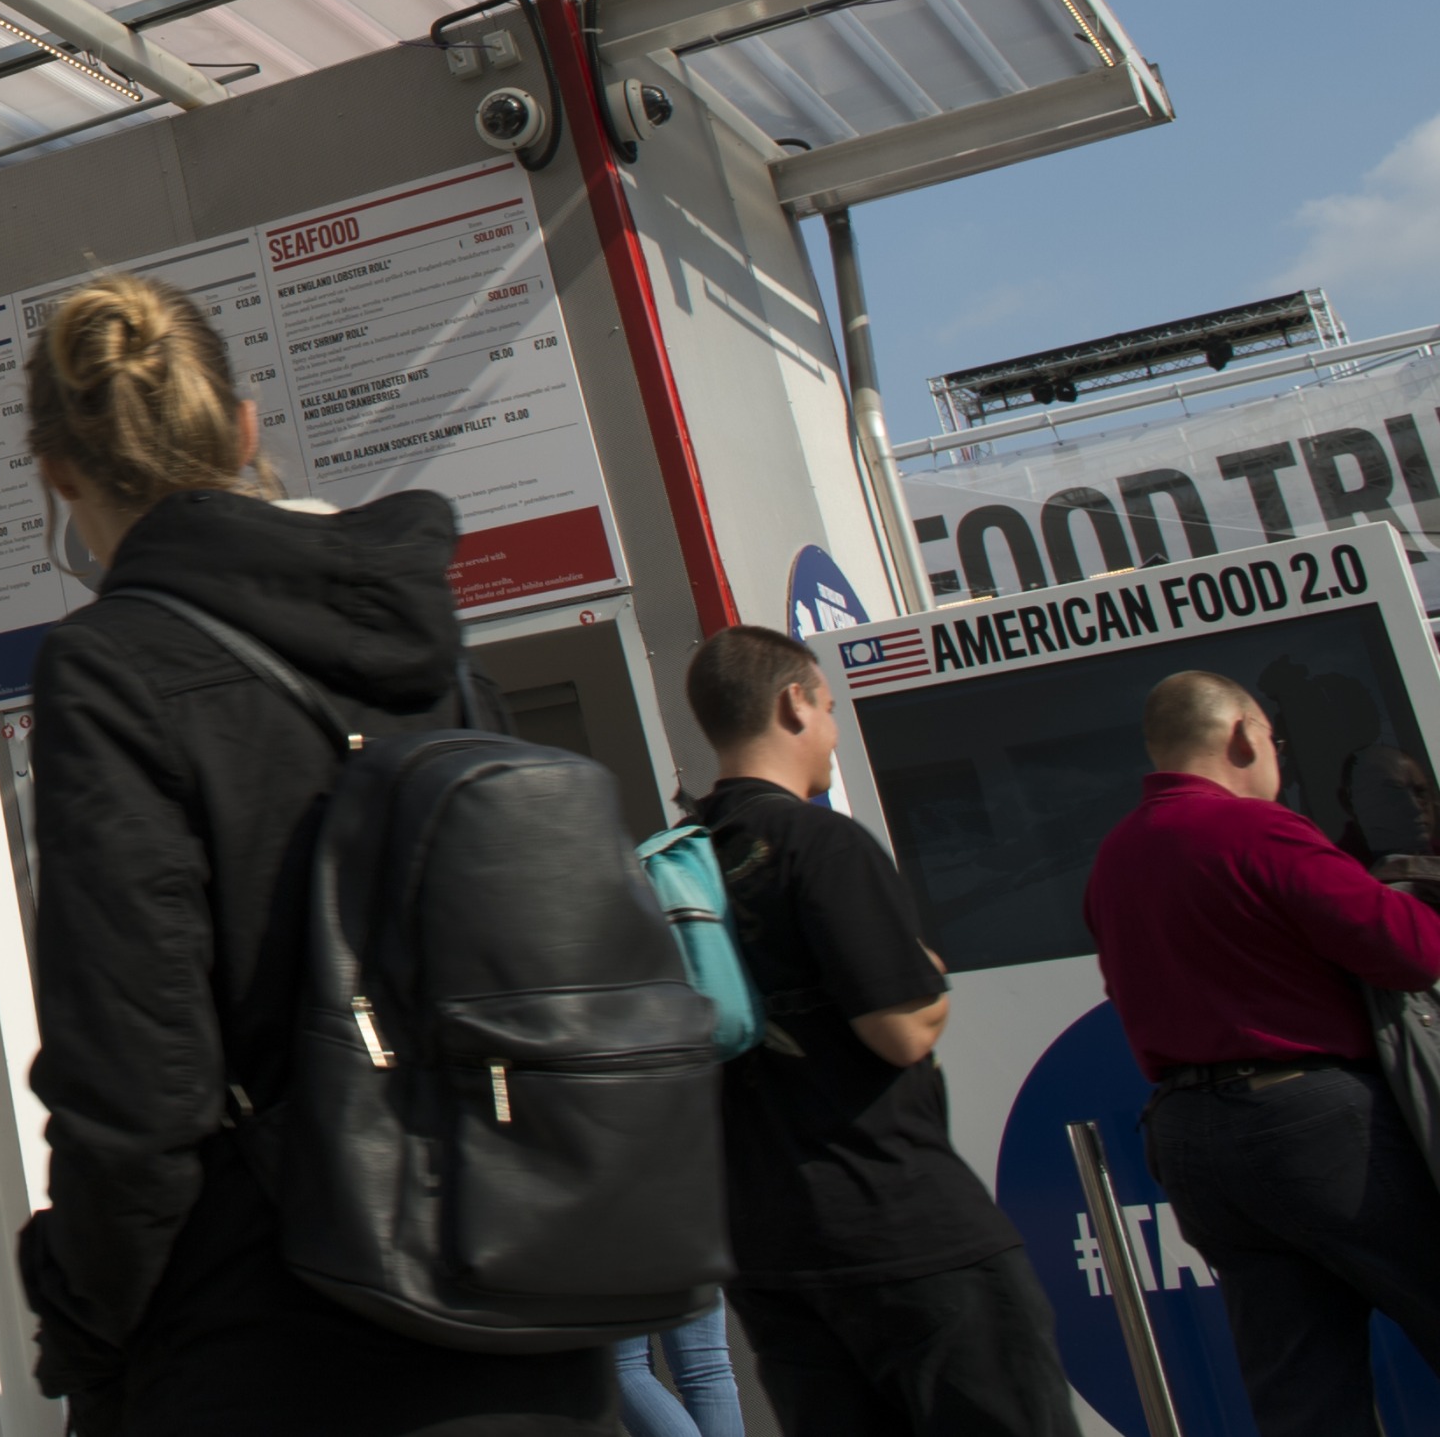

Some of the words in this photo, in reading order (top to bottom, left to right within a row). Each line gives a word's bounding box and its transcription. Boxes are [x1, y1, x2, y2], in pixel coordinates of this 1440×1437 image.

[269, 217, 359, 262] SEAFOOD
[474, 231, 494, 243] SOLD
[496, 225, 514, 238] OUT!
[278, 286, 295, 298] NEW
[297, 276, 332, 293] ENGLAND
[333, 266, 368, 283] LOBSTER
[488, 290, 508, 301] SOLD
[510, 284, 528, 296] OUT!
[236, 295, 261, 310] €13.00
[289, 341, 312, 354] SPICY
[314, 333, 344, 348] SHRIMP
[490, 347, 513, 361] €5.00
[534, 337, 557, 350] €7.00
[301, 397, 321, 409] KALE
[322, 389, 347, 403] SALAD
[349, 384, 370, 396] WITH
[371, 374, 406, 391] TOASTED
[407, 368, 429, 382] NUTS
[304, 409, 320, 421] AND
[322, 403, 344, 416] DRIED
[345, 389, 400, 410] CRANBERRIES
[314, 456, 330, 468] ADD
[331, 451, 352, 463] WILD
[354, 442, 390, 458] ALASKAN
[392, 432, 428, 450] SOCKEYE
[430, 424, 463, 440] SALMON
[505, 409, 529, 423] €3.00
[491, 552, 506, 560] with
[931, 584, 1158, 673] AMERICAN
[1161, 560, 1288, 629] FOOD
[1291, 544, 1368, 604] 2.0
[1073, 1202, 1219, 1296] #TA
